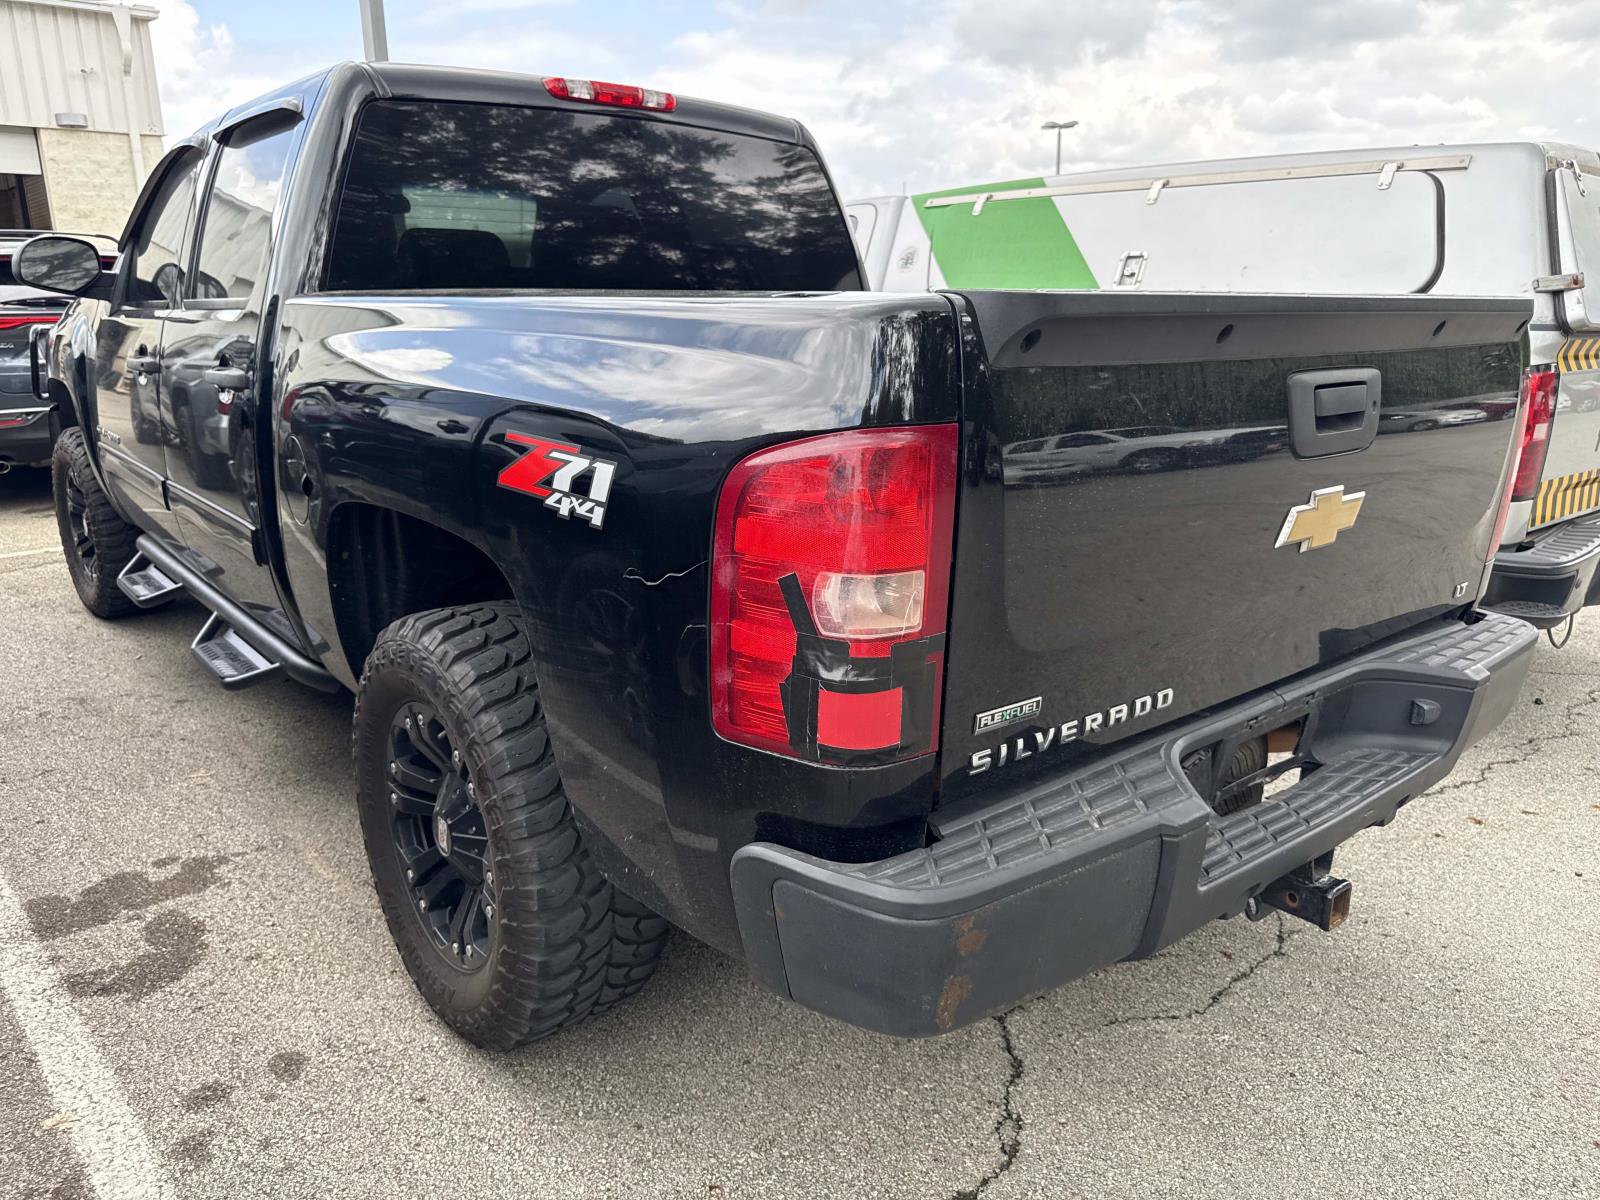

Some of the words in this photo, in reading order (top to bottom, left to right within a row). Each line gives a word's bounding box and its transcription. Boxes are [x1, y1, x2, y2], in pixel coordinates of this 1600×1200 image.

[499, 431, 615, 503] Z71
[1455, 581, 1469, 598] LT
[968, 687, 1174, 776] SILVERADO
[979, 701, 1040, 728] FLEXFUEL
